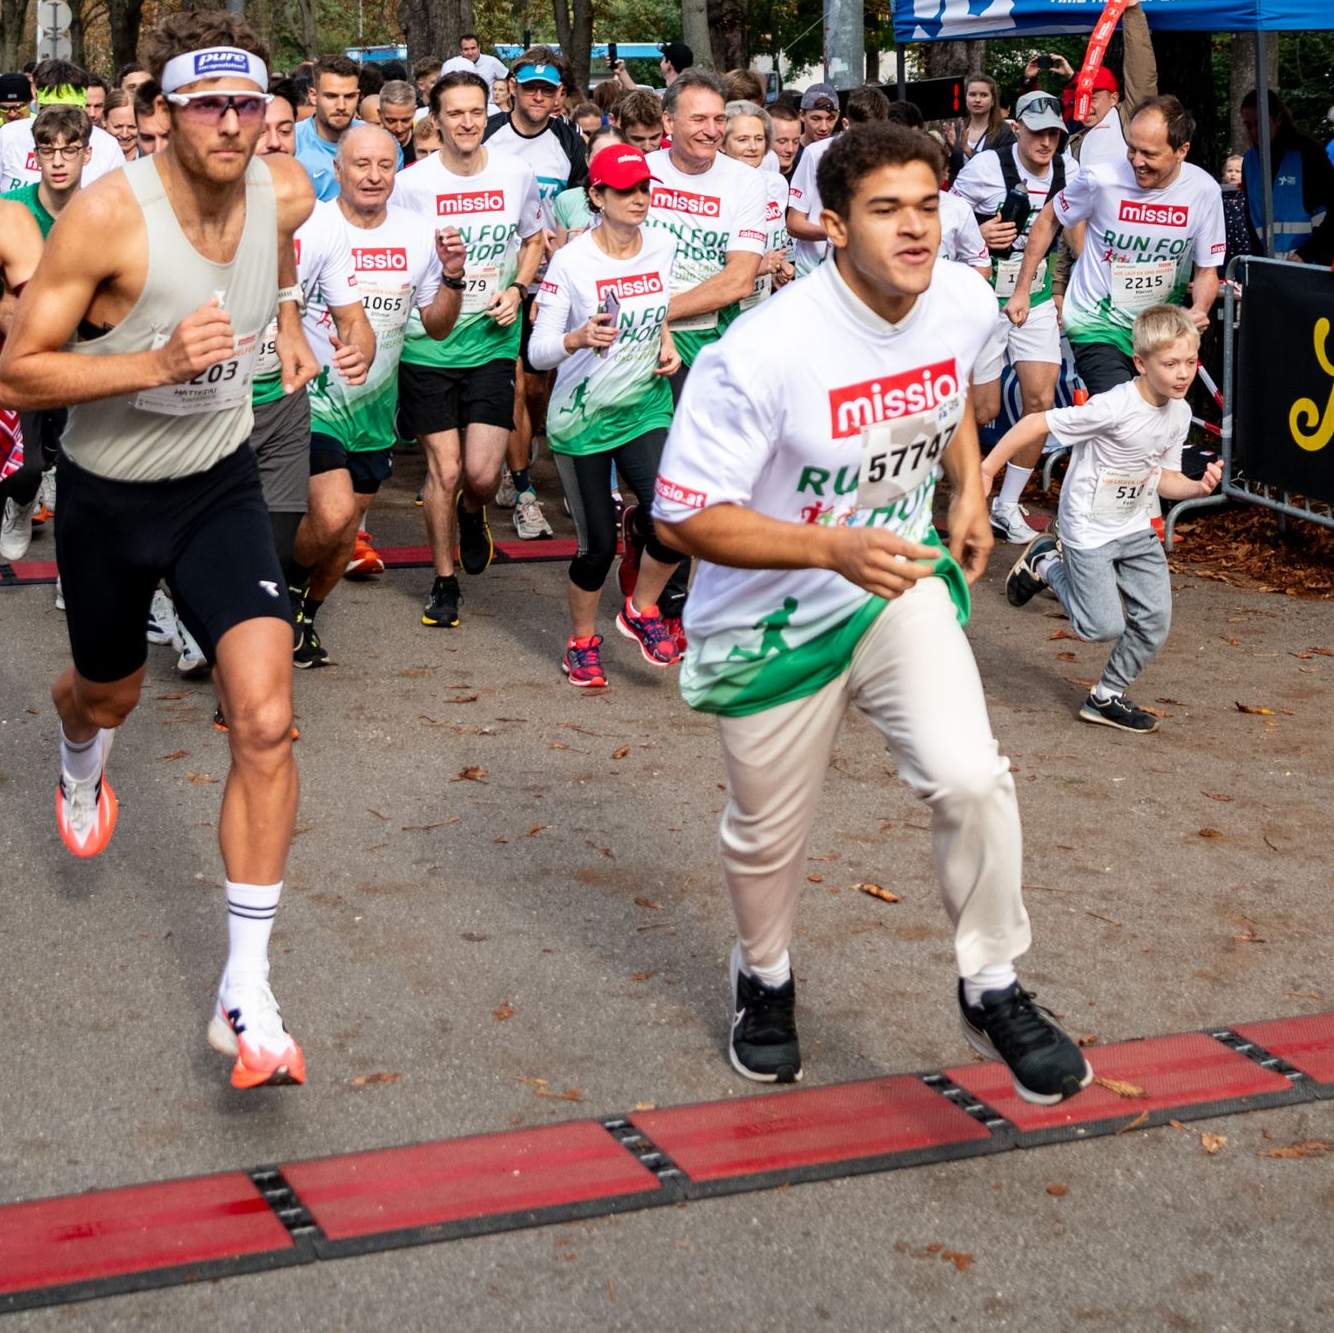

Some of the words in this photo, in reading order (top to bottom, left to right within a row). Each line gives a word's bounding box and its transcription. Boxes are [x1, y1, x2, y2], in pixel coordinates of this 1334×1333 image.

[198, 52, 246, 66] pure
[617, 152, 643, 163] missio
[439, 192, 504, 213] missio
[653, 191, 718, 215] missio
[1122, 204, 1187, 226] missio
[690, 228, 730, 249] FOR
[1103, 229, 1152, 251] RUN
[352, 249, 406, 269] issio
[467, 243, 505, 261] HOP
[599, 272, 662, 302] missio
[1125, 275, 1163, 290] 2215
[363, 295, 402, 311] 1065
[640, 305, 667, 326] FO
[619, 323, 662, 345] HOP
[836, 369, 957, 433] missio
[868, 422, 957, 483] 57747
[796, 464, 861, 497] RU
